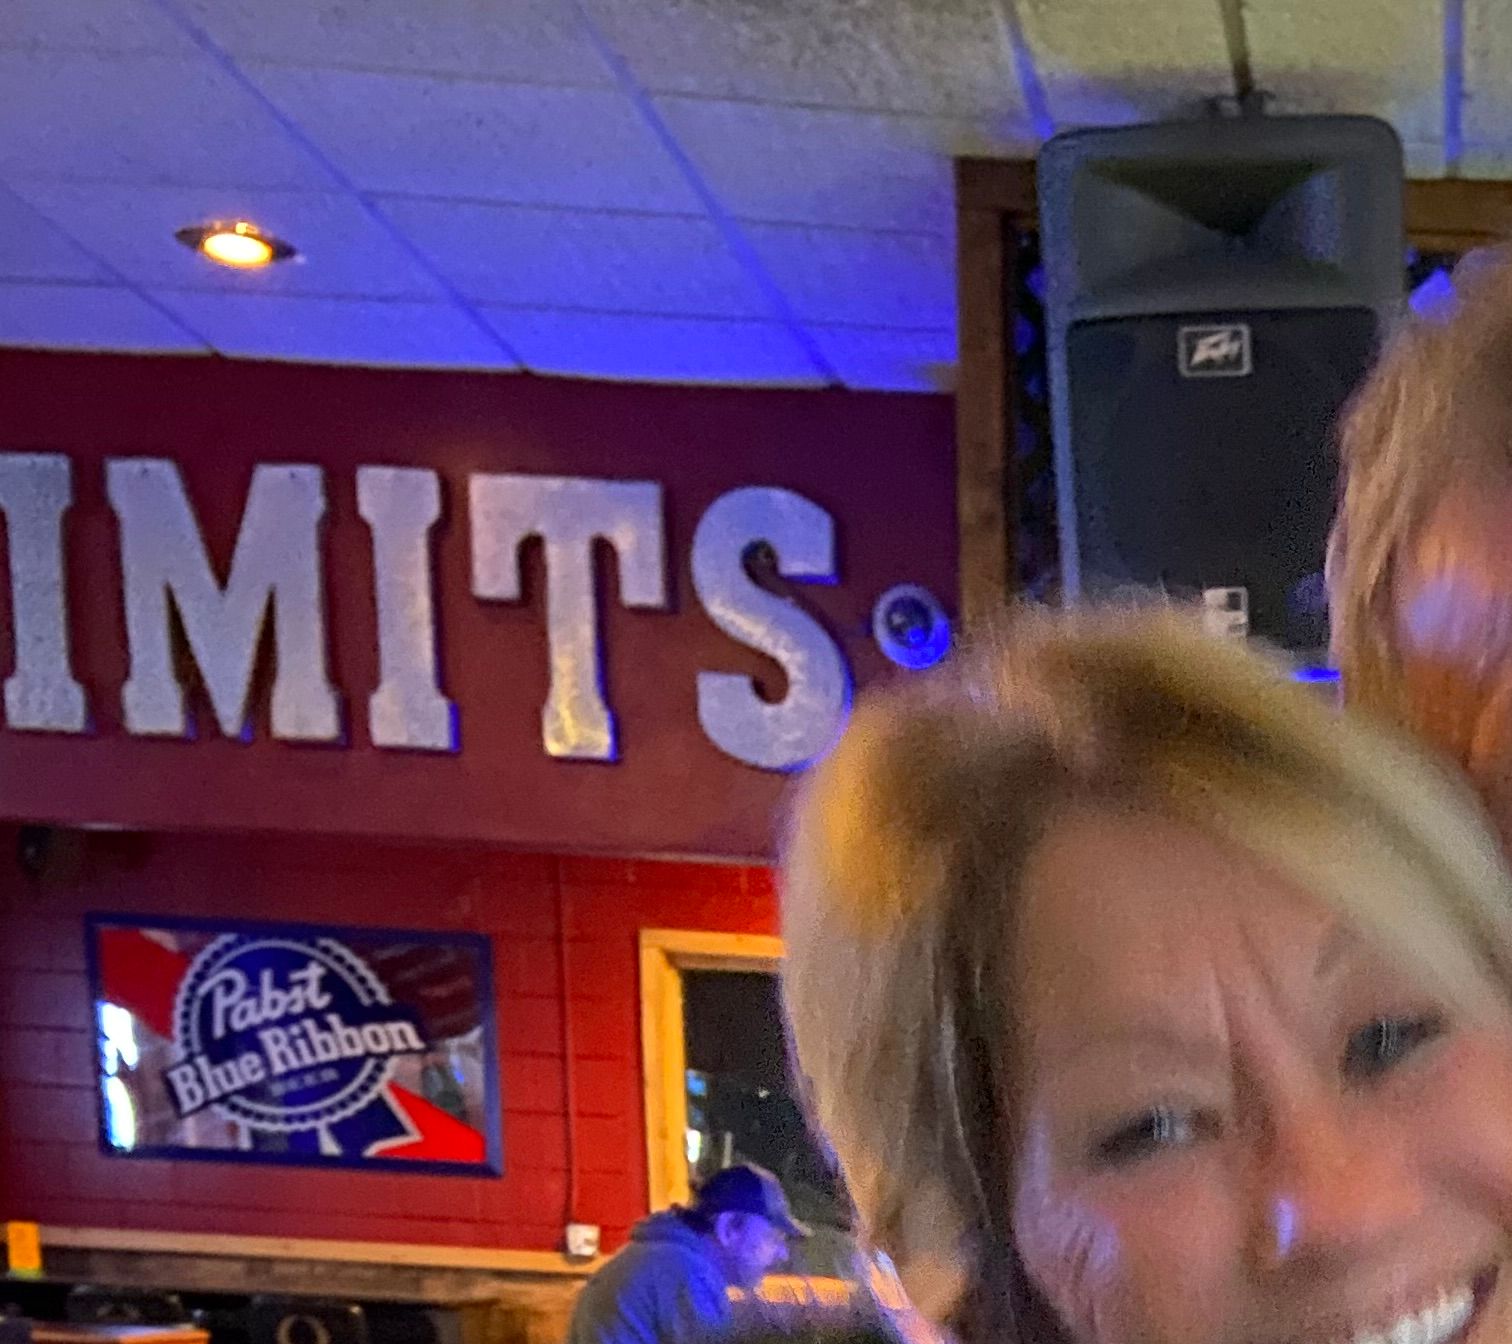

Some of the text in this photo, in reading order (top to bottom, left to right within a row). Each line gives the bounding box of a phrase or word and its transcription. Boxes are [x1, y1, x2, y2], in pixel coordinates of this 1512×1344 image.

[0, 452, 854, 772] IMITS
[199, 961, 332, 1040] Pabst
[167, 1055, 266, 1114] Blue
[259, 1014, 426, 1076] Ribbon
